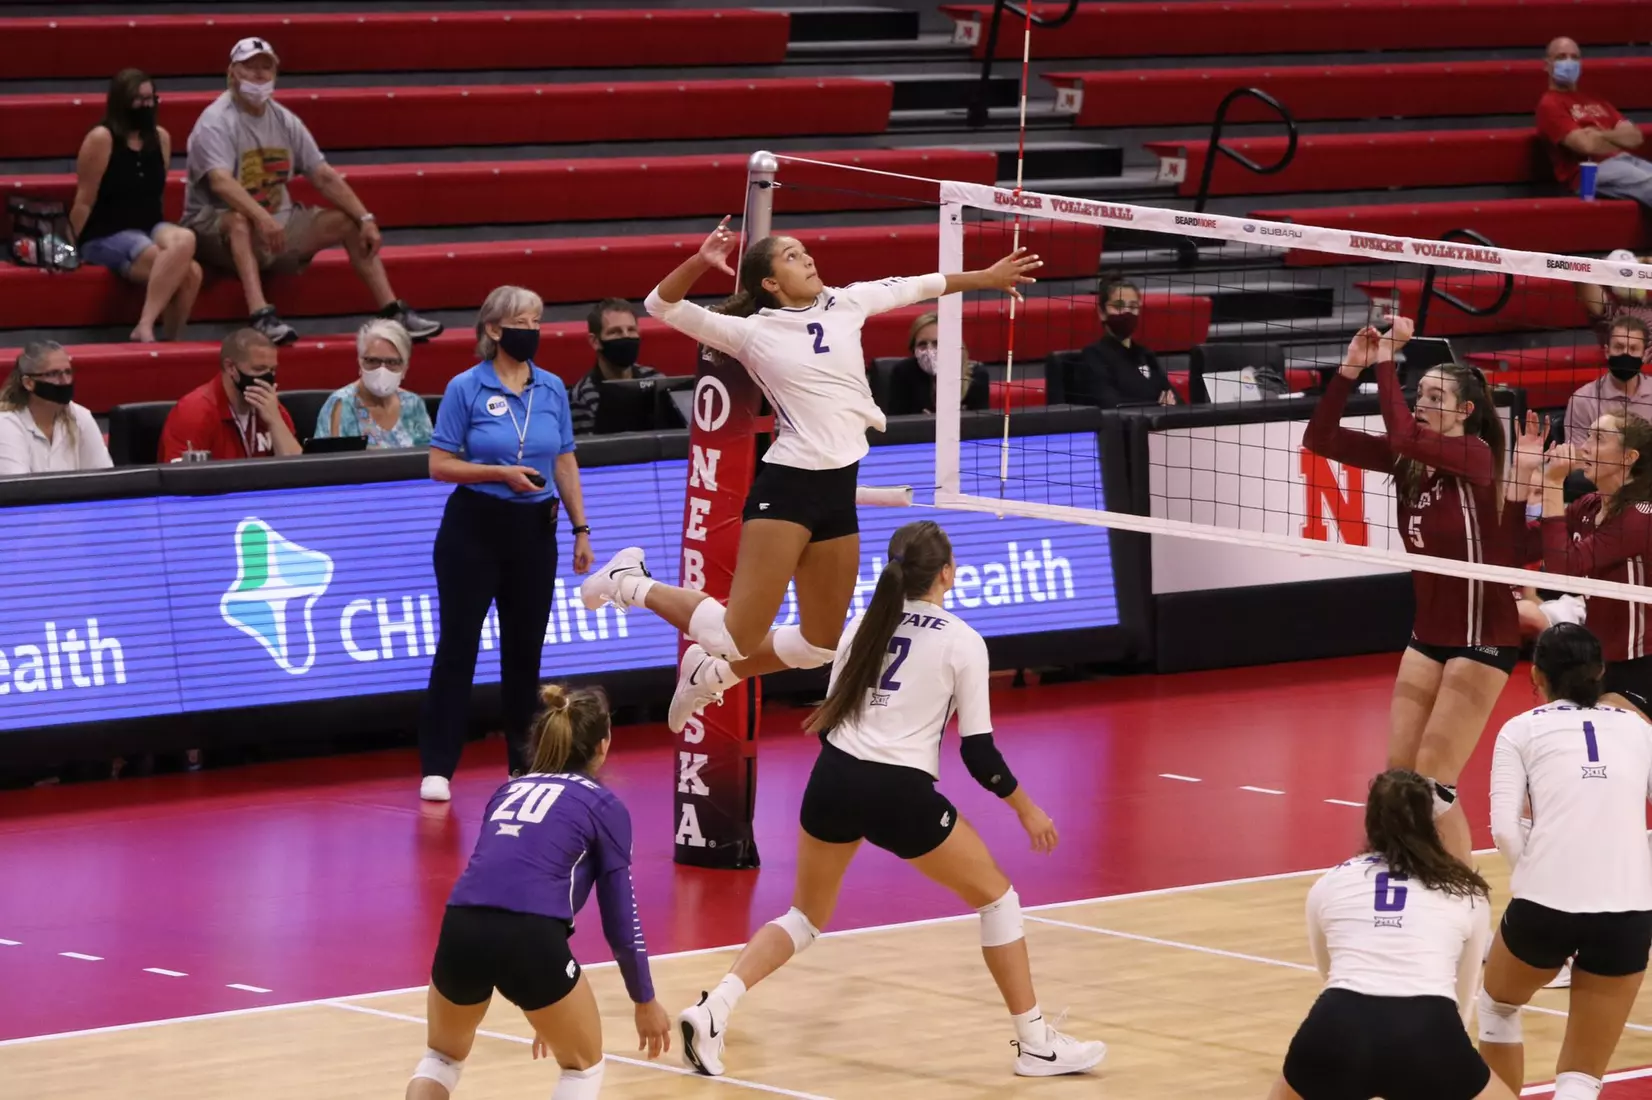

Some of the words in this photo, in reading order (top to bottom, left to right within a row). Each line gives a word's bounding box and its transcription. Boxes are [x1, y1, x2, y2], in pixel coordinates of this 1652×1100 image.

[993, 191, 1042, 209] HUSKER
[1050, 198, 1134, 221] VOLLEYBALL
[1174, 215, 1217, 229] BEARDMORE
[1259, 226, 1303, 238] SUBARU
[1349, 234, 1404, 254] HUSKER
[1411, 242, 1502, 264] VOLLEYBALL
[1546, 259, 1592, 273] BEARDMORE
[806, 322, 831, 354] 2
[256, 431, 273, 452] N
[1298, 445, 1371, 548] N
[1408, 515, 1425, 549] 5
[943, 538, 1076, 610] ealth
[339, 593, 437, 662] CHI
[901, 612, 949, 631] TATE
[674, 444, 722, 848] NEBSKA
[1582, 720, 1599, 762] 1
[489, 782, 566, 824] 20
[1374, 871, 1409, 912] 6
